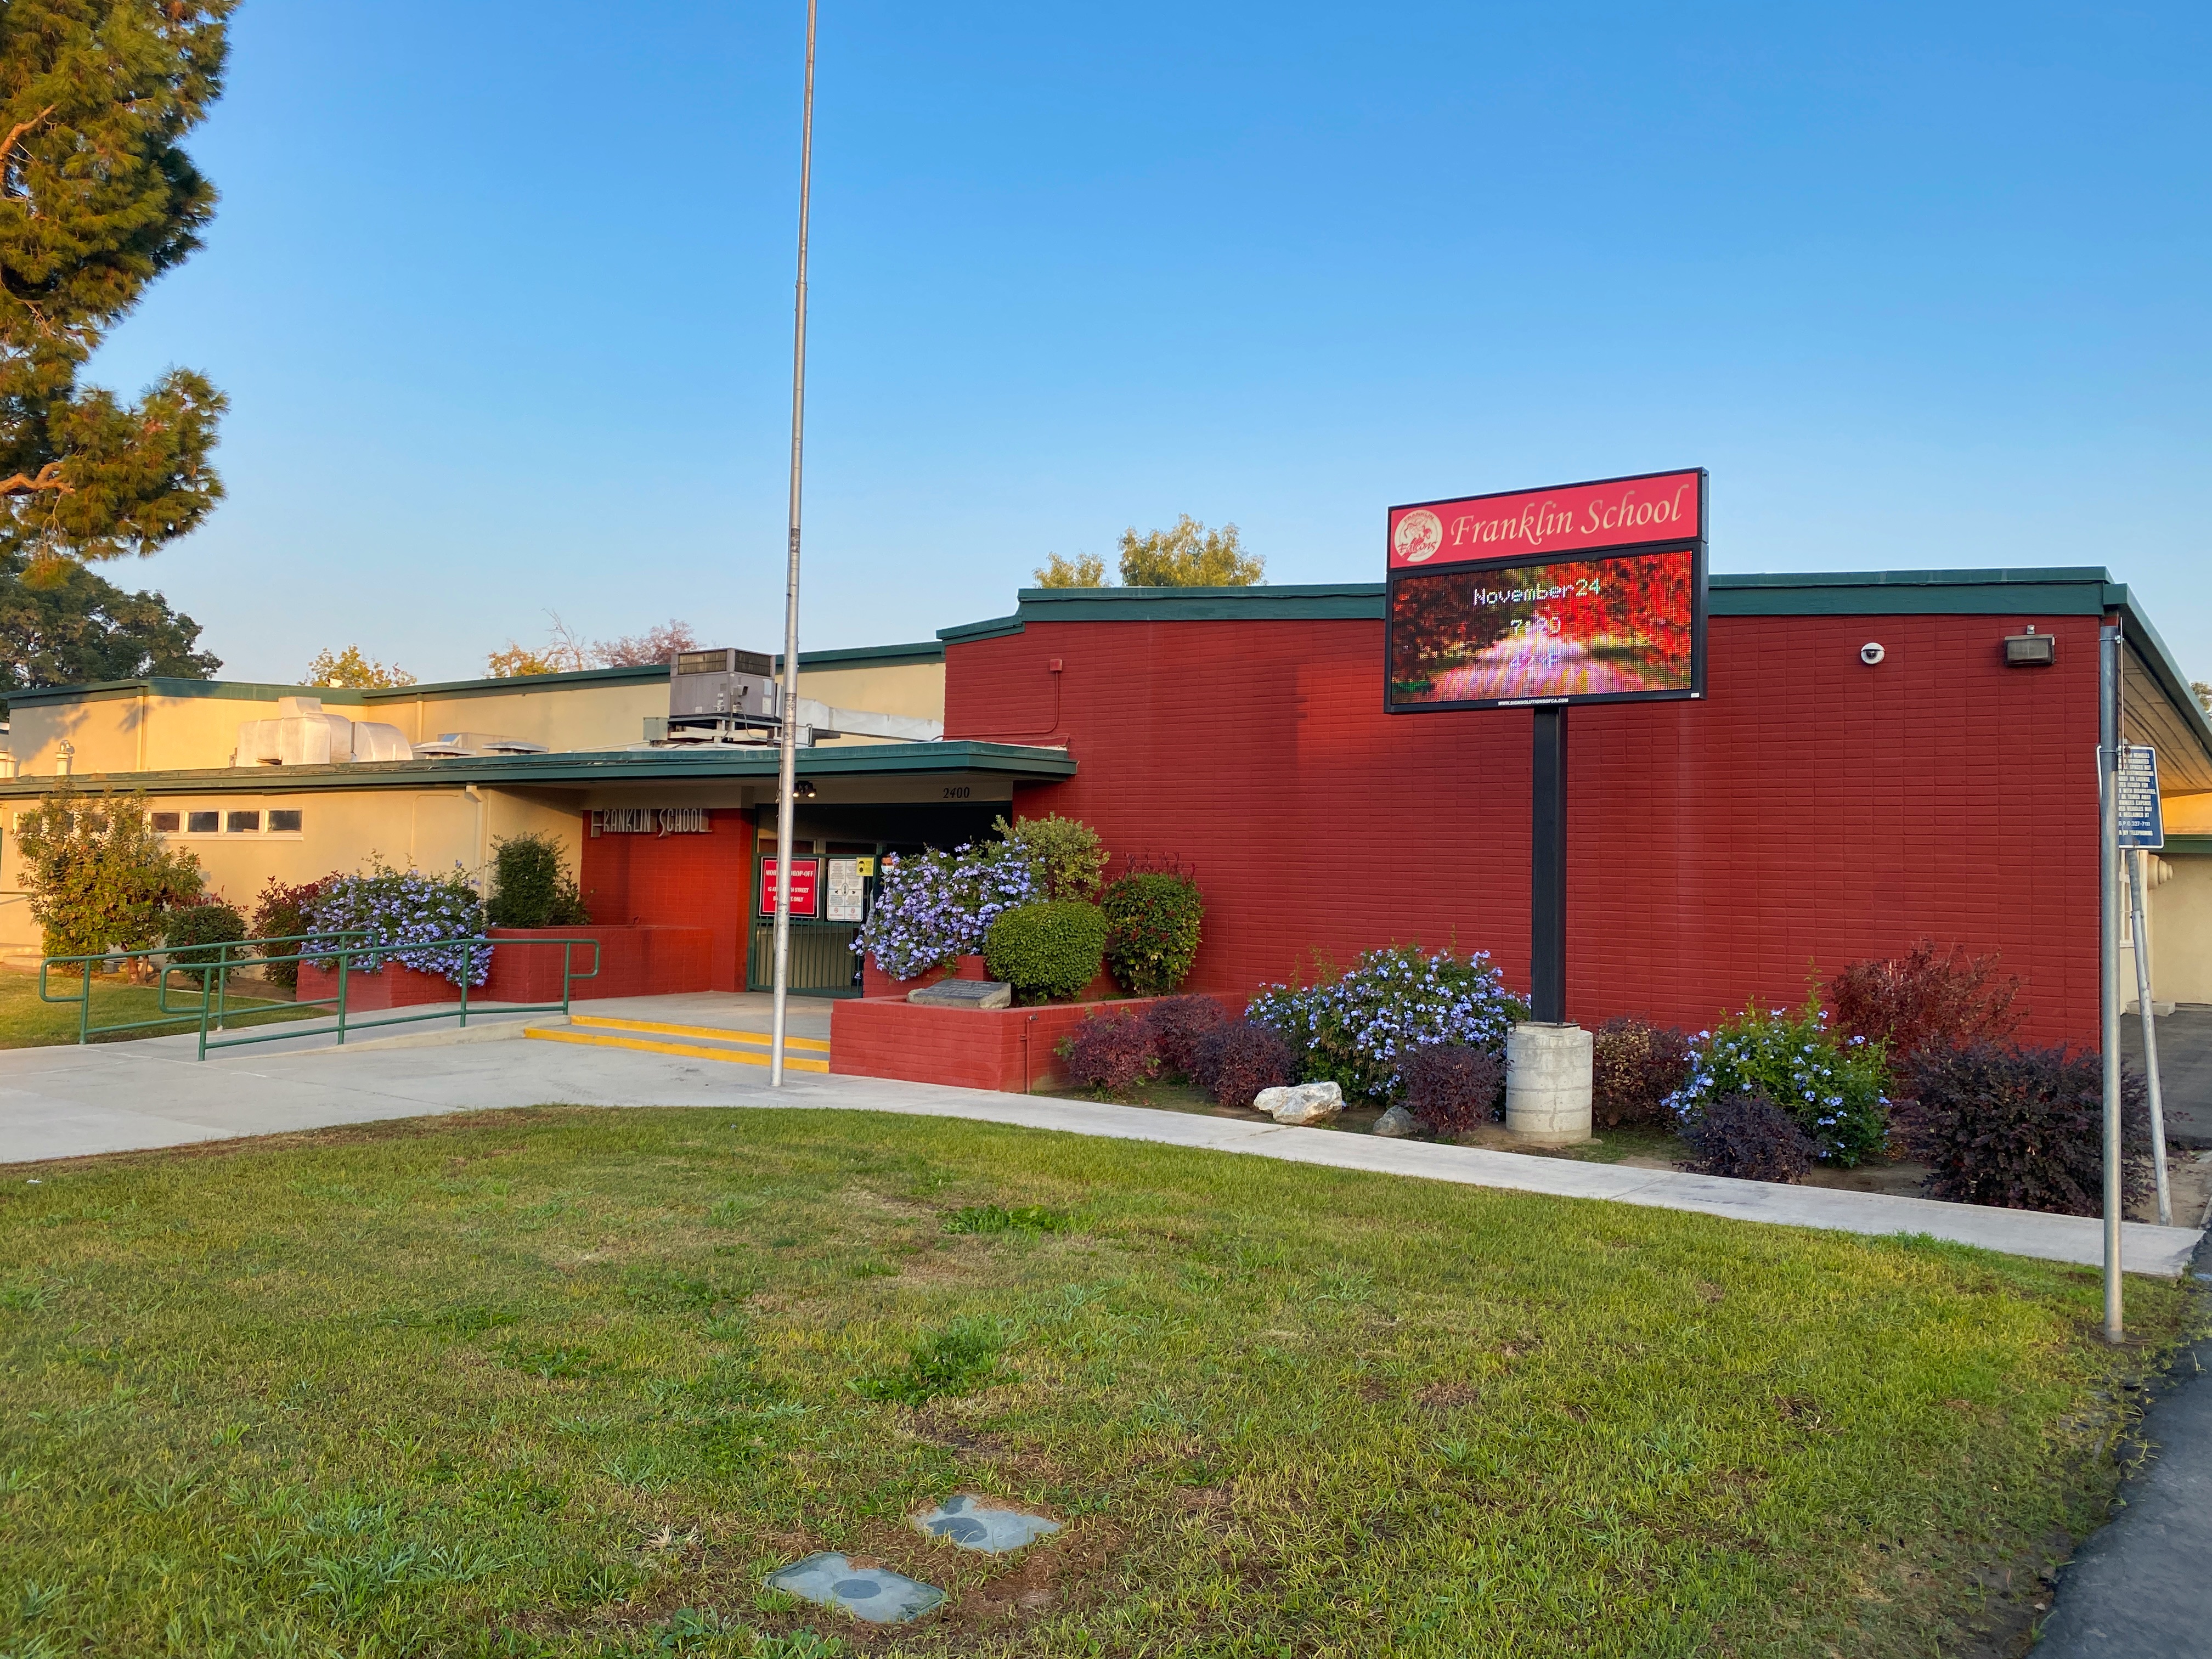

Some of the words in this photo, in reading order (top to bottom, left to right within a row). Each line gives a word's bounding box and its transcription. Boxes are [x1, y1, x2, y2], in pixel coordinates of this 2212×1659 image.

[1404, 512, 1434, 523] FRANKLIN
[1451, 500, 1573, 545] Franklin
[1581, 484, 1689, 534] School
[1397, 541, 1437, 553] Falcons
[943, 787, 970, 799] 2400
[591, 809, 651, 838] FRANKLIN
[658, 808, 707, 838] SCHOOL
